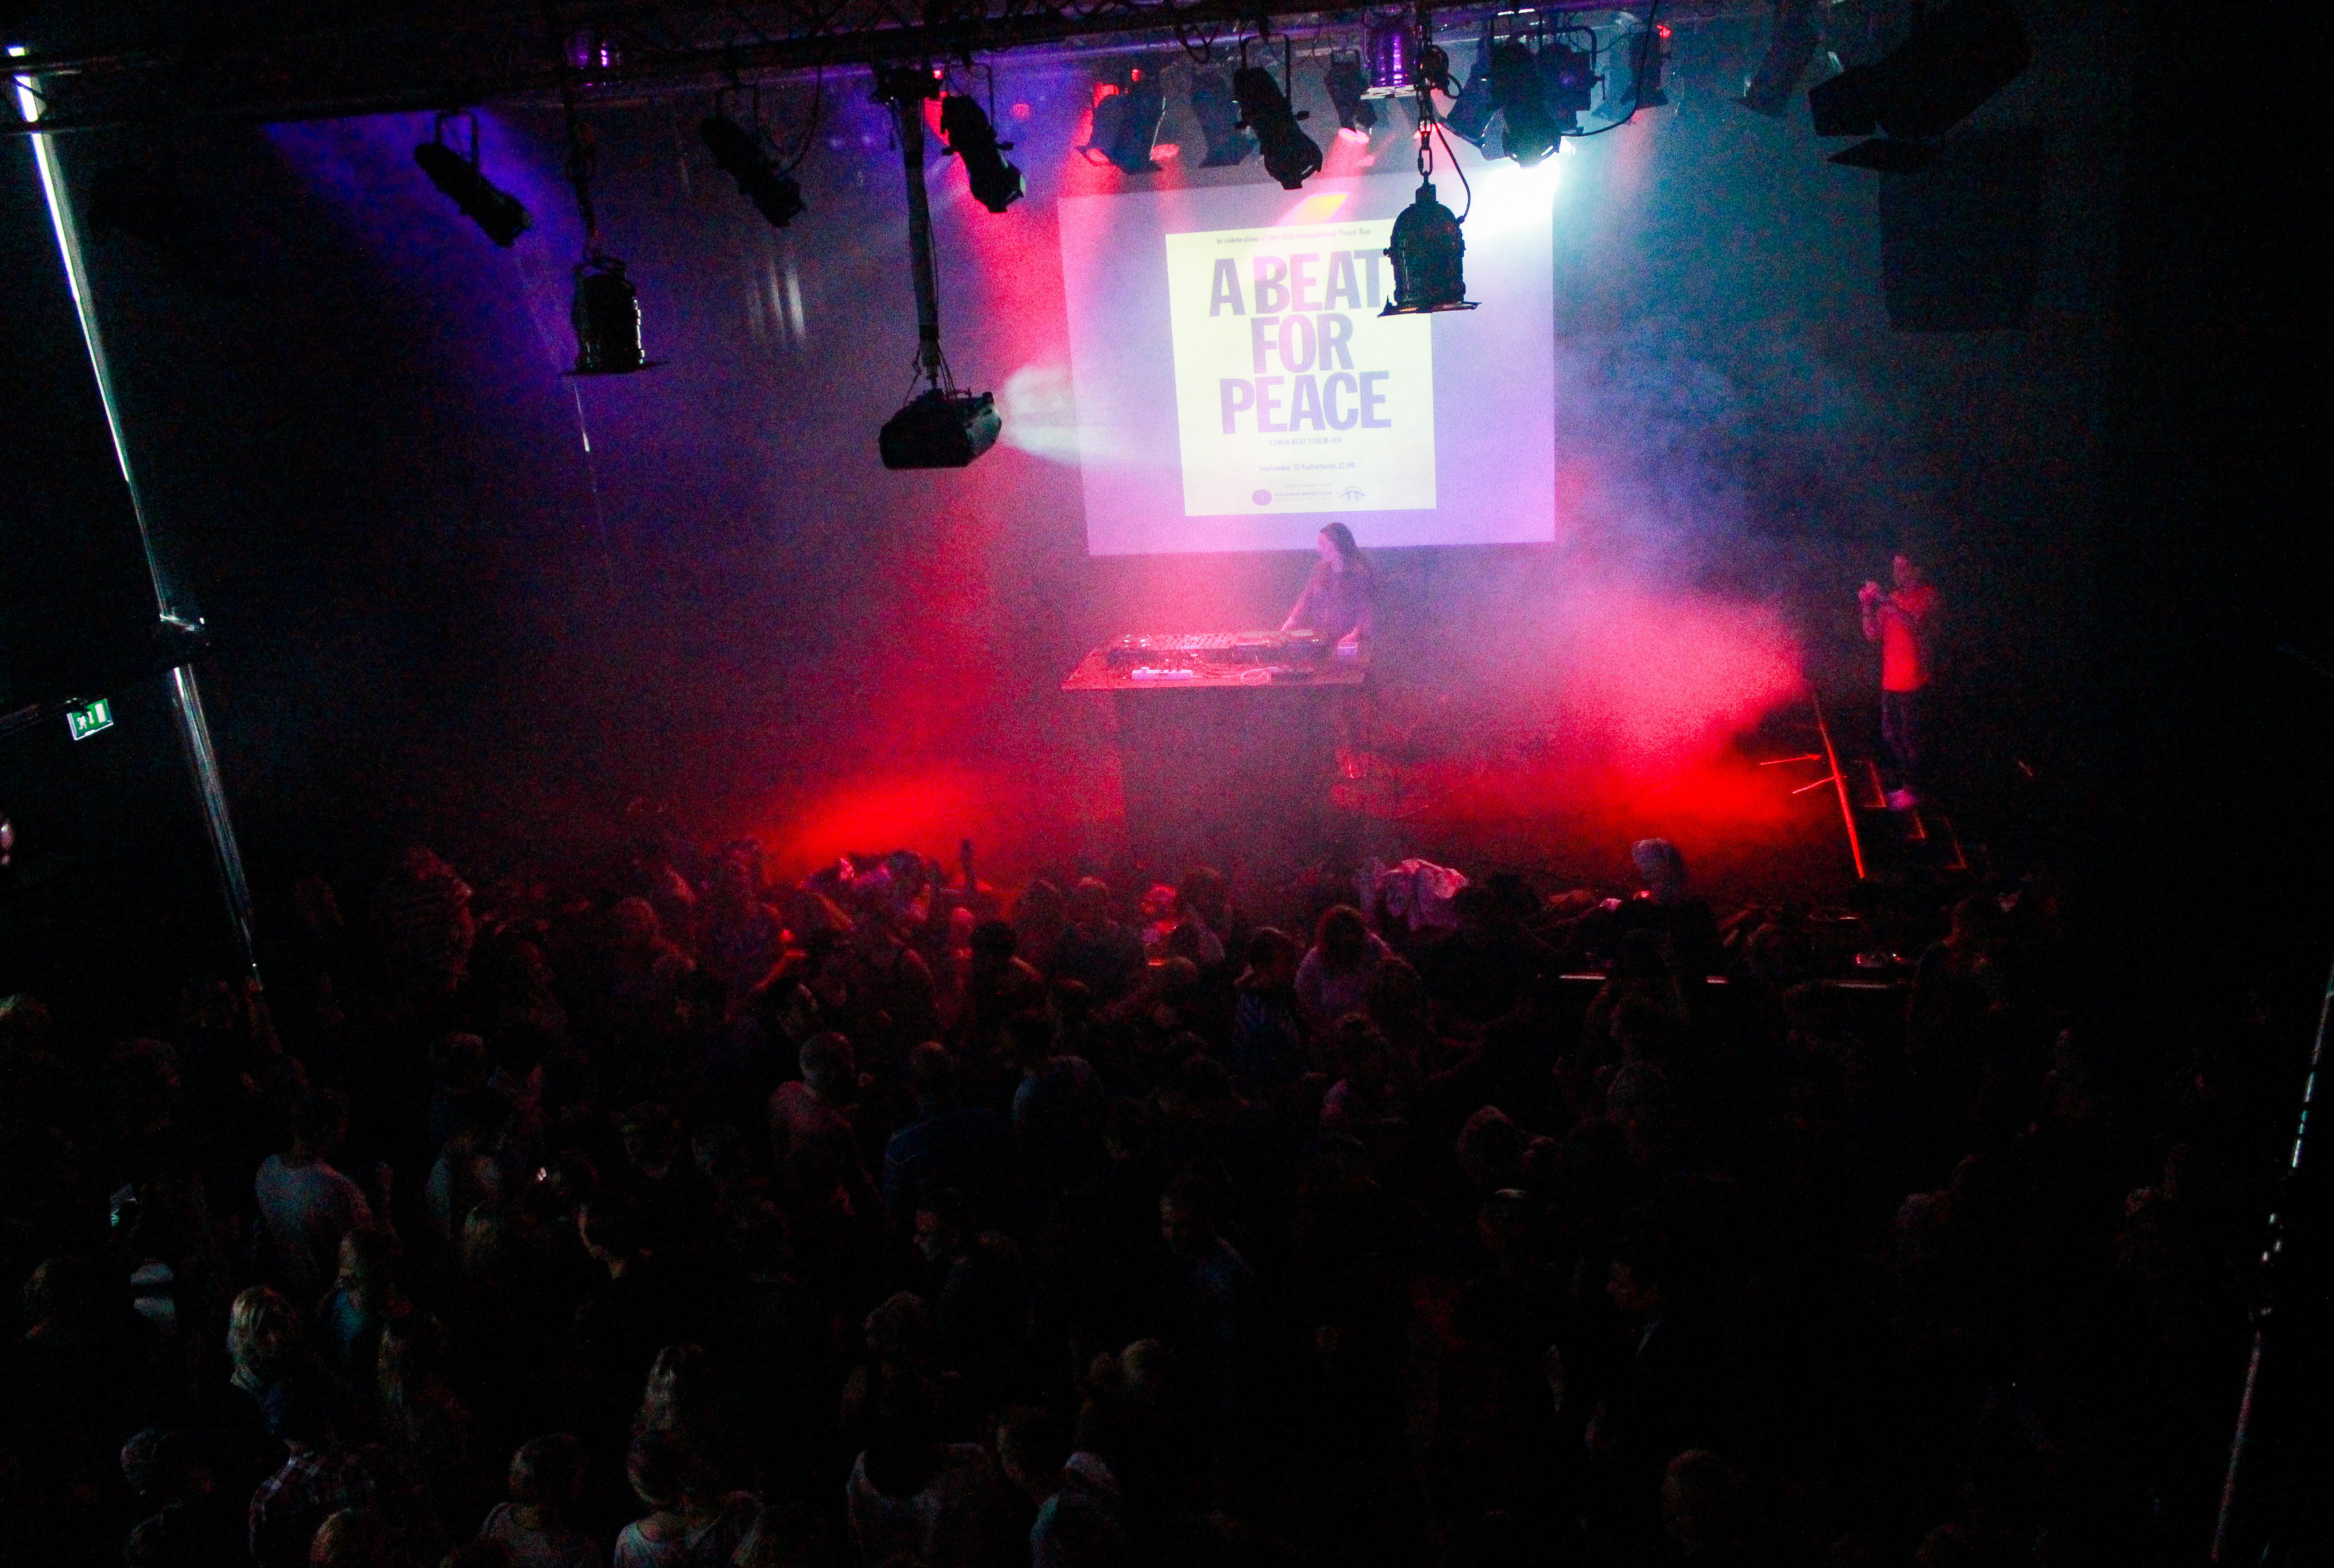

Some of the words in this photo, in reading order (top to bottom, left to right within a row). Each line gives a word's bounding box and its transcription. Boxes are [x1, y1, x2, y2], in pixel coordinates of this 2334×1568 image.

[1210, 259, 1245, 316] A
[1253, 249, 1384, 314] BEAT
[1251, 313, 1354, 373] FOR
[1220, 371, 1391, 434] PEACE
